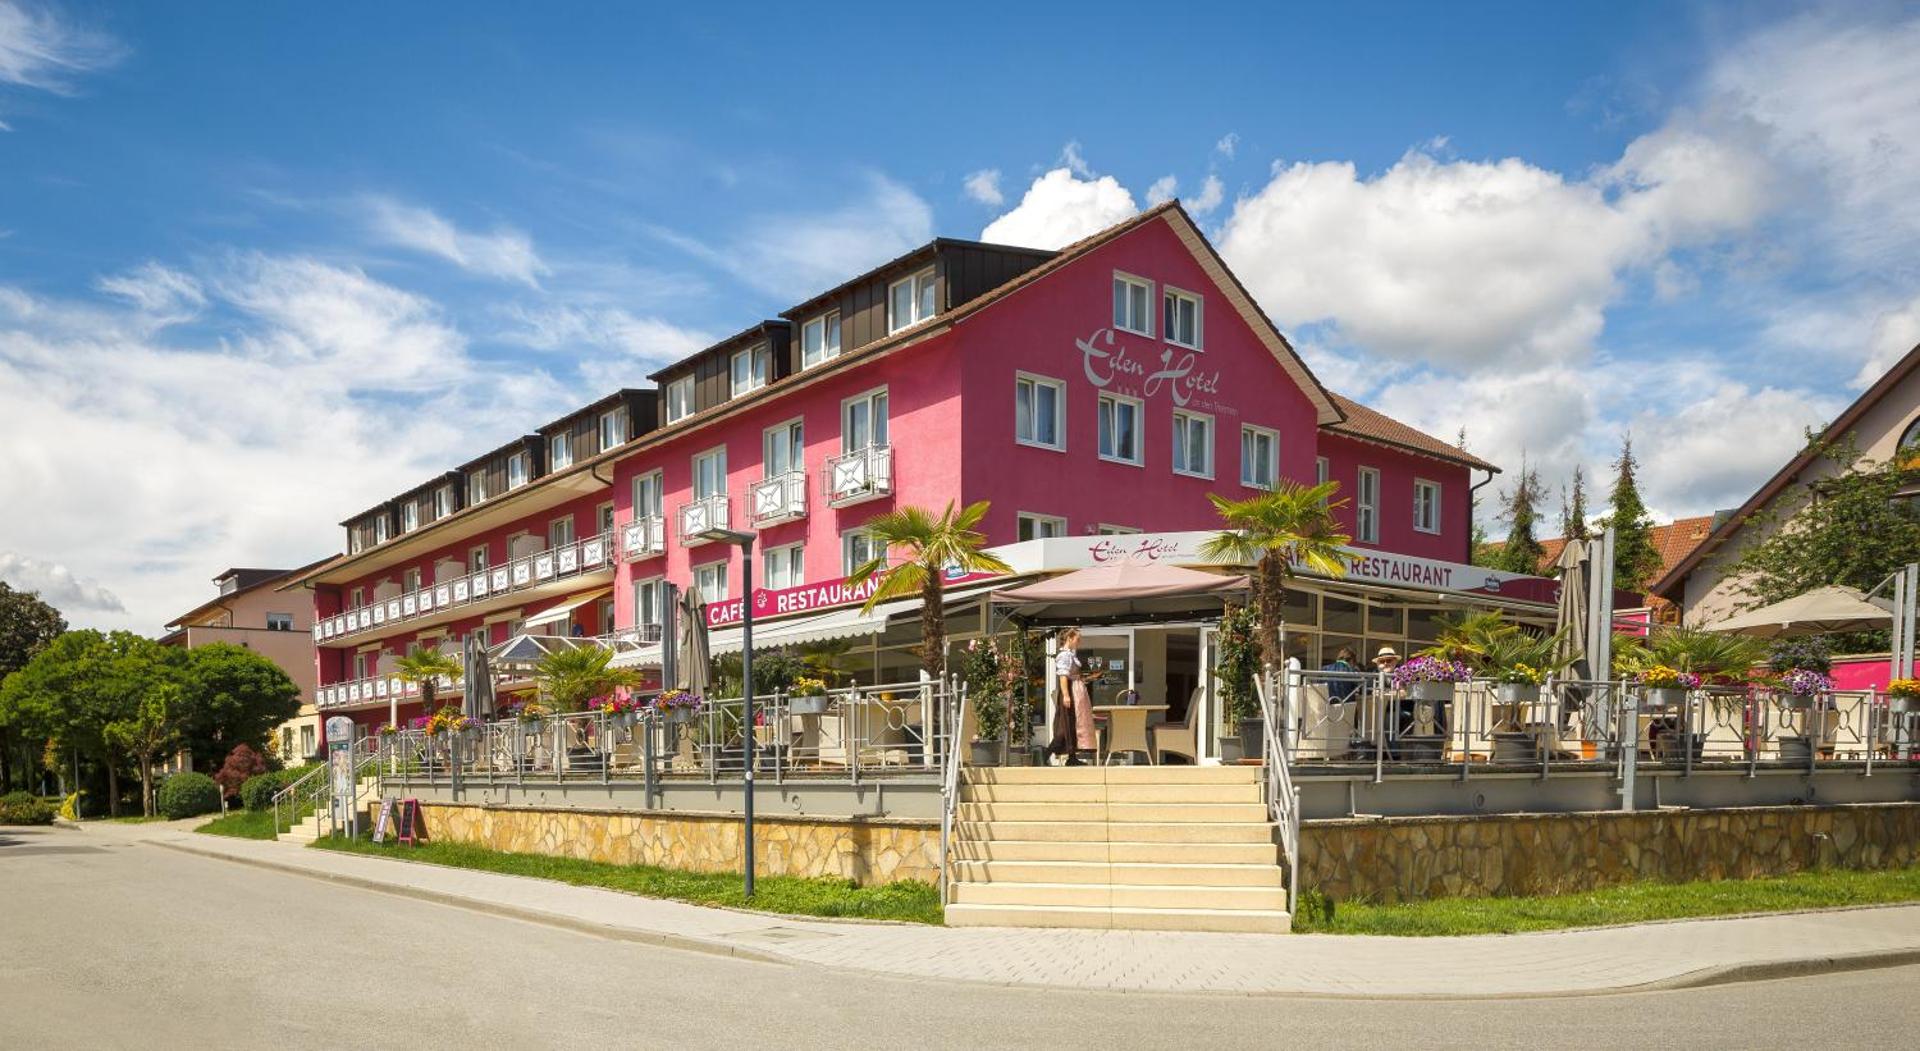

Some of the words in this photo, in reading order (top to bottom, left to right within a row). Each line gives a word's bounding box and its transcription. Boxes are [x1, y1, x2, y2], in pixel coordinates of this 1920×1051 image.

[1075, 328, 1145, 387] Eden
[1144, 349, 1220, 407] Hotel
[1088, 540, 1127, 562] Eden
[1131, 538, 1179, 560] Hotel
[1351, 556, 1452, 587] RESTAURANT
